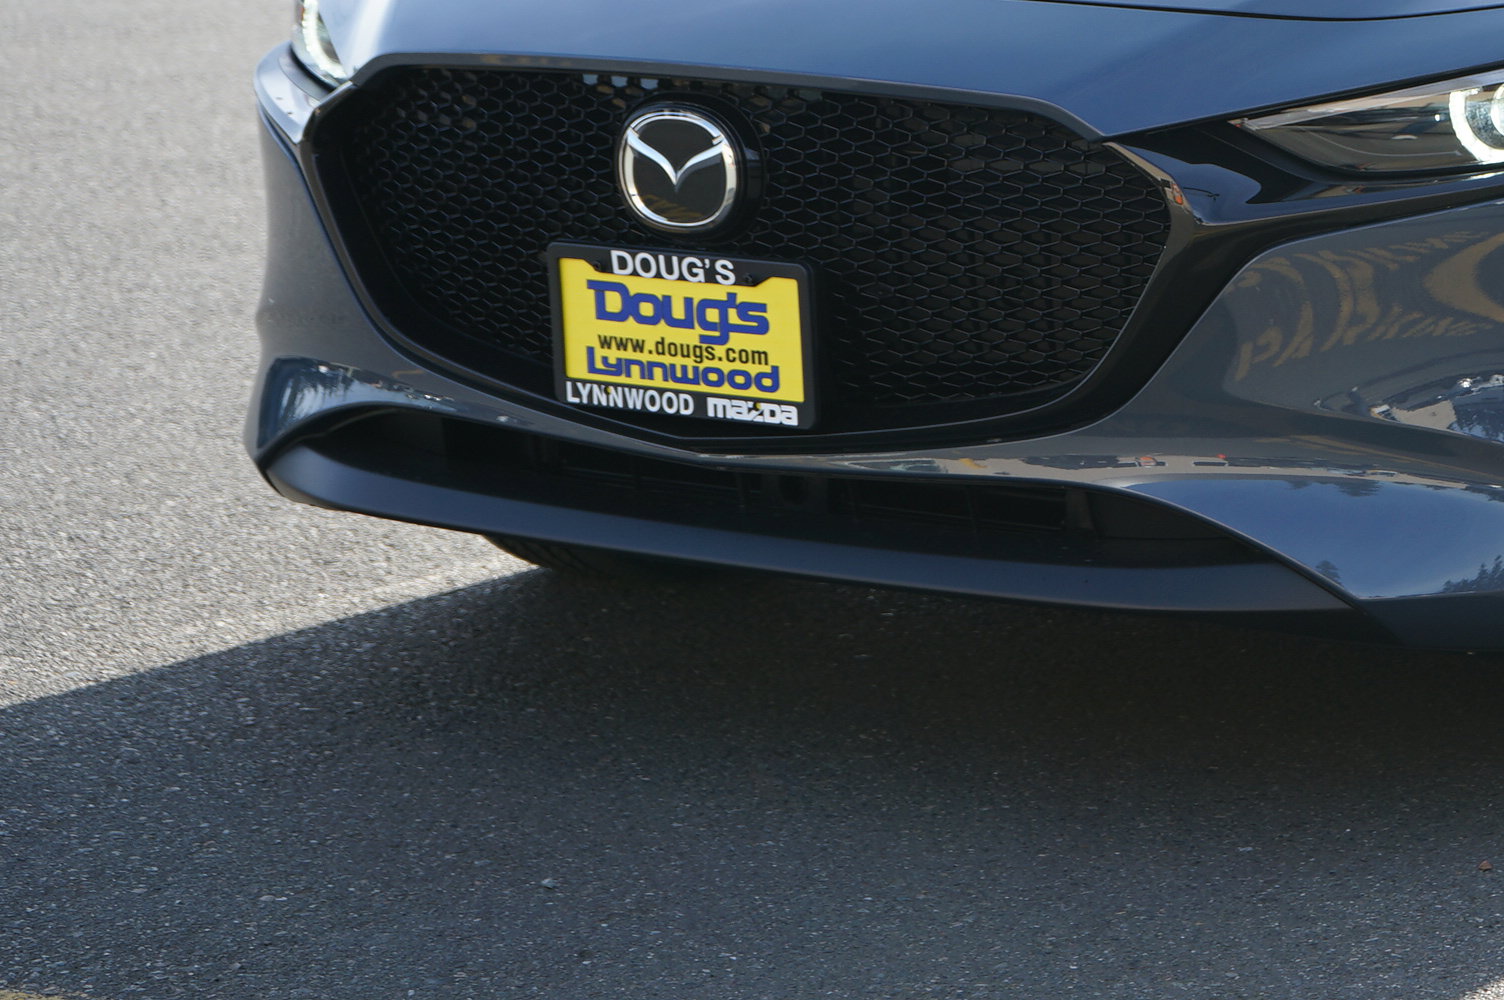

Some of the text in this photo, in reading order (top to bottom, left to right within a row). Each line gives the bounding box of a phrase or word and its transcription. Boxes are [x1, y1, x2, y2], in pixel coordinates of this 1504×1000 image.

[610, 250, 736, 286] DOUG'S
[586, 279, 770, 346] Doug's
[597, 334, 769, 366] www.dougs.com
[586, 346, 780, 394] Lynnwood
[565, 381, 695, 416] LYNNWOOD
